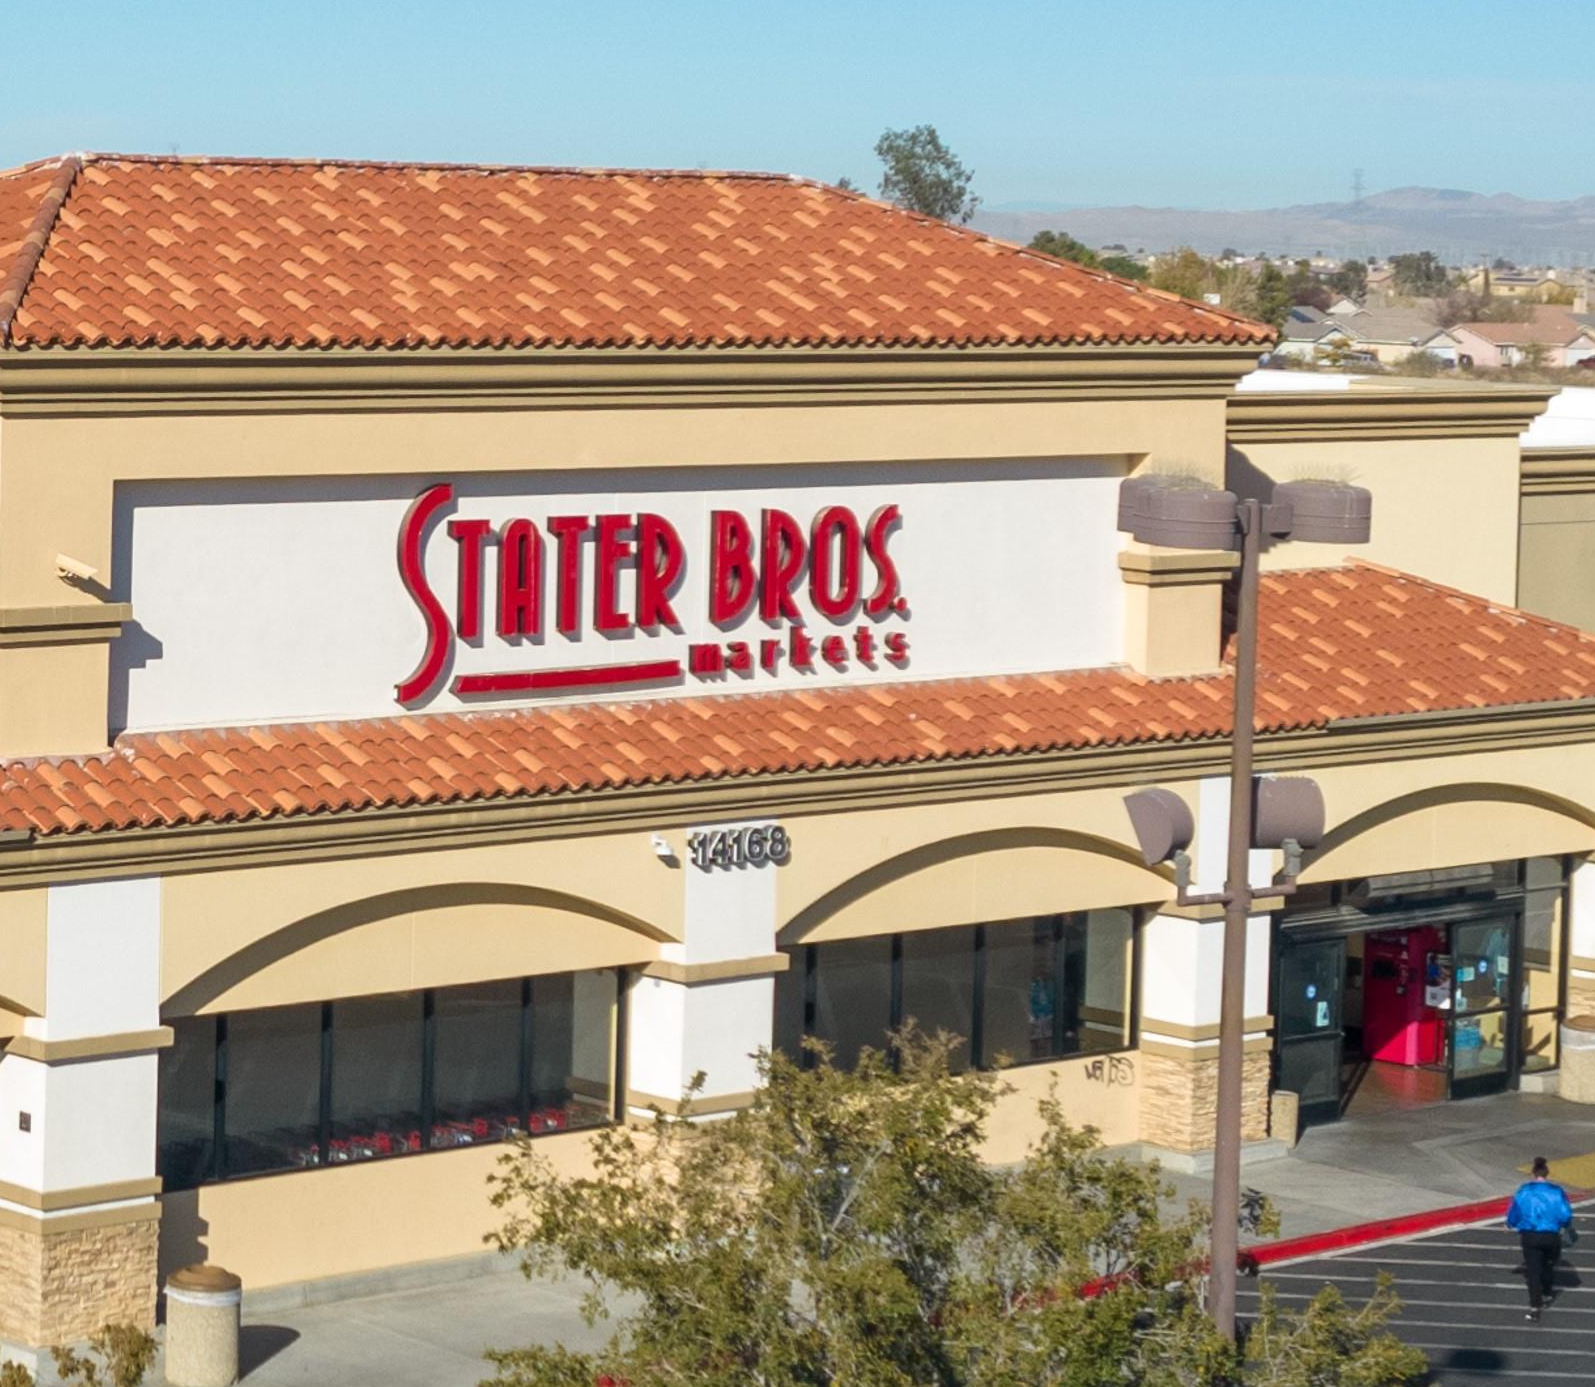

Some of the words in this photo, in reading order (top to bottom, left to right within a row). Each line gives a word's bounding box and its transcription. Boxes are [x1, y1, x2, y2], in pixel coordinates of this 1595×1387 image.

[393, 482, 684, 708] STATER
[711, 504, 909, 625] BROS.
[689, 626, 908, 676] markets
[689, 825, 789, 866] 14168
